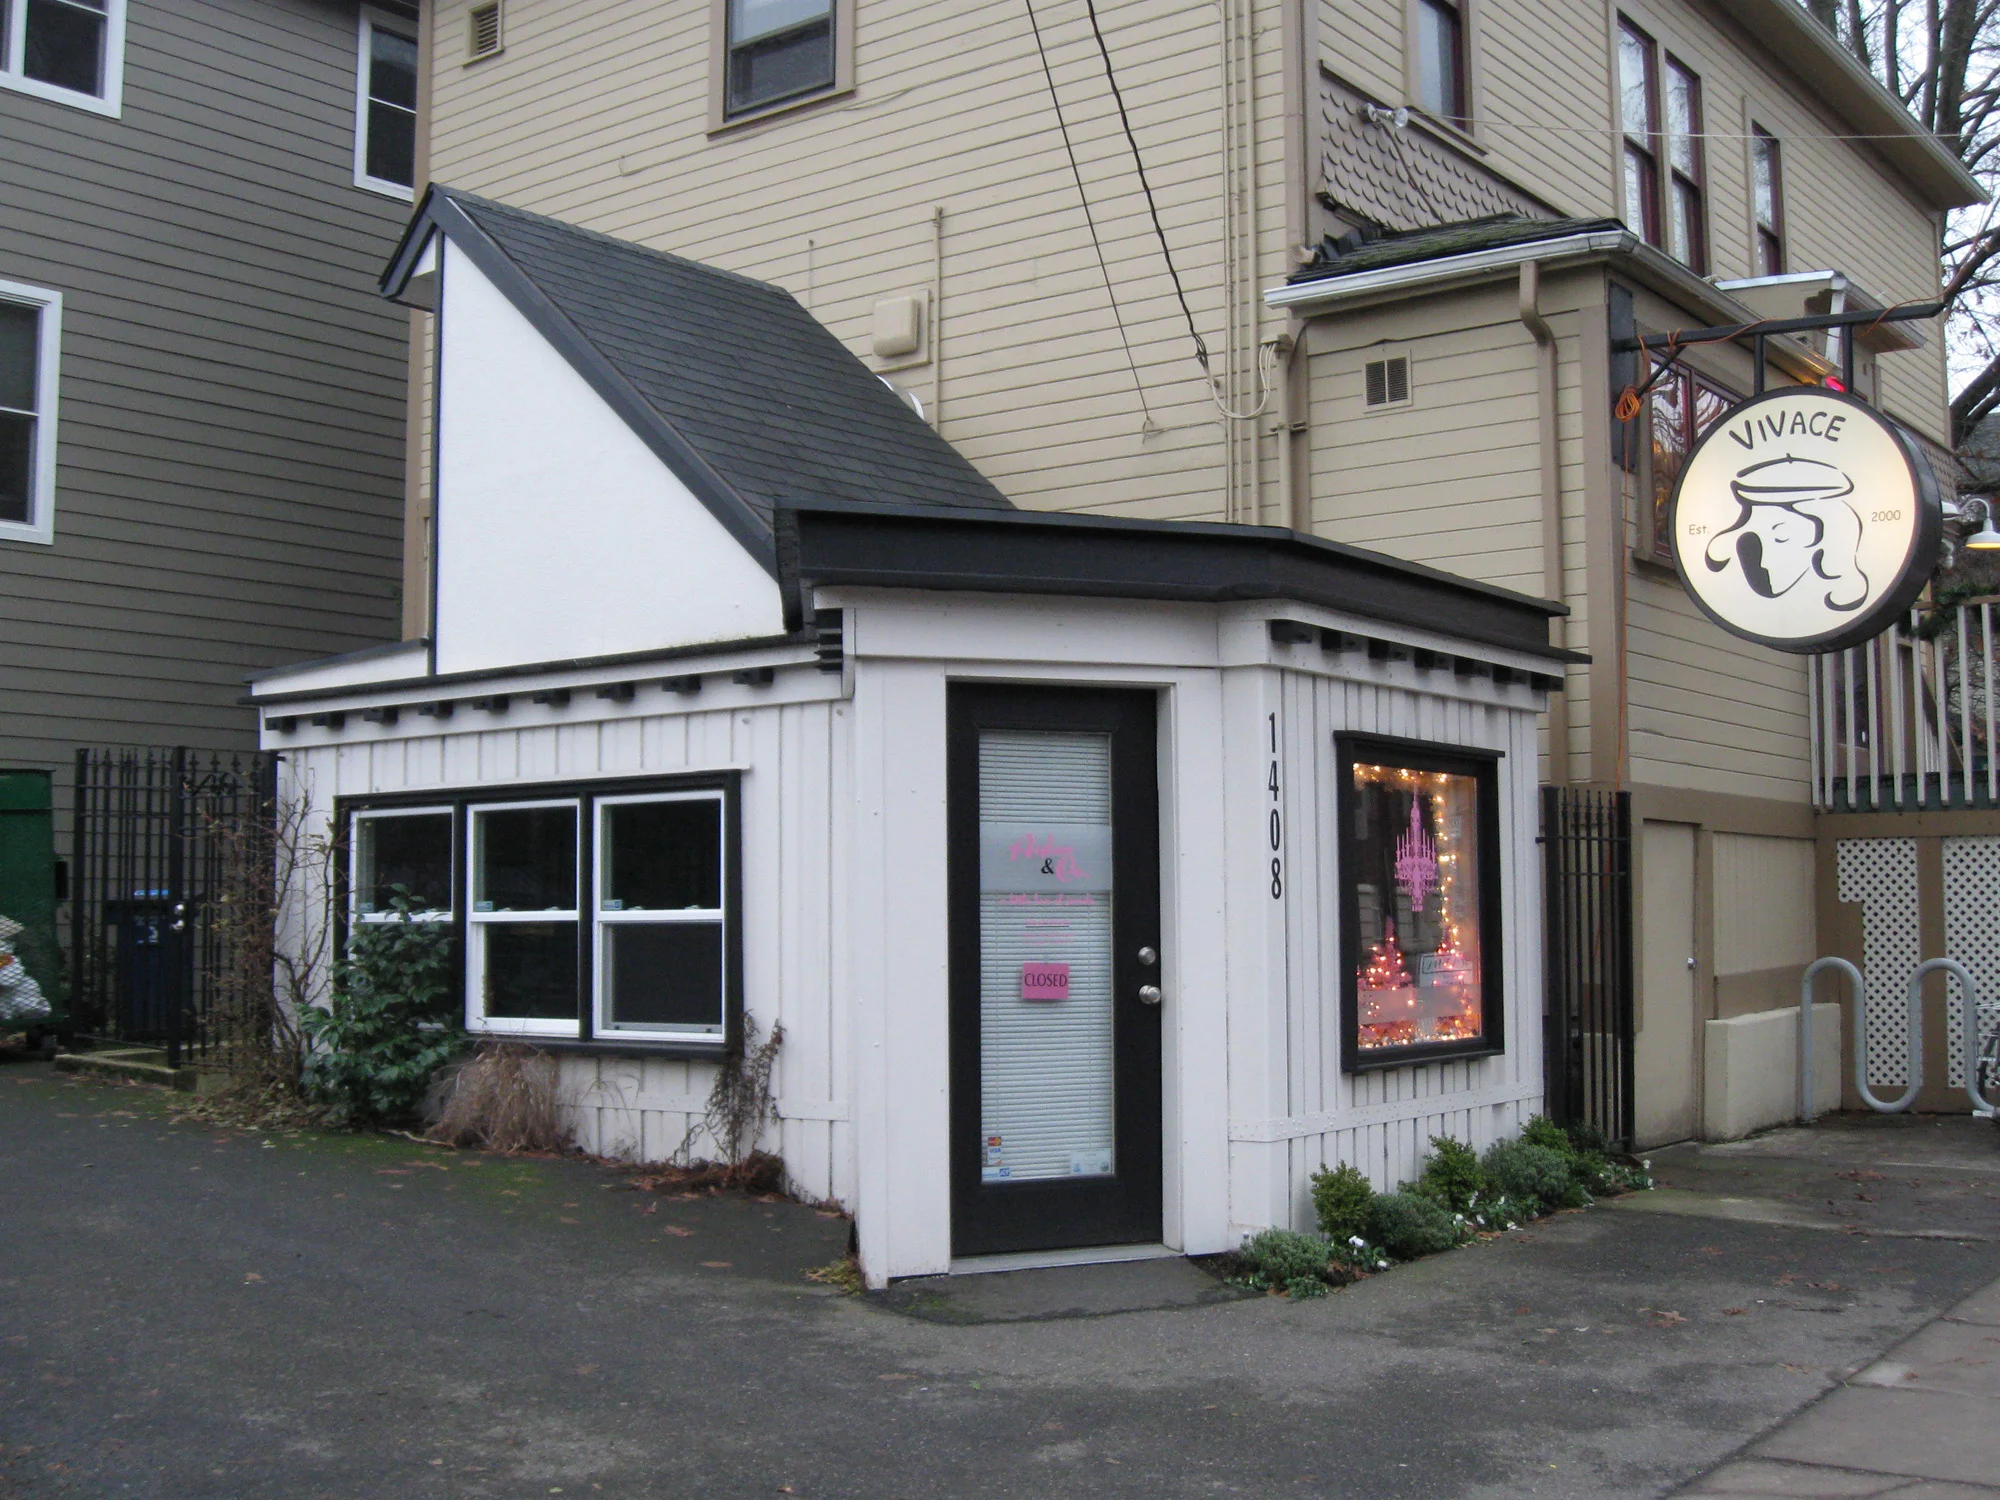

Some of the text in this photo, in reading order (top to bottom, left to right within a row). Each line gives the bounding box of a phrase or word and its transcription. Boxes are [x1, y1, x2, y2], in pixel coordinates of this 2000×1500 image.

[1728, 410, 1847, 451] VIVACE
[1871, 509, 1901, 523] 2000
[1688, 524, 1710, 536] Est.
[1268, 712, 1282, 900] 1408
[1040, 857, 1055, 875] &
[1023, 972, 1068, 988] CLOSED
